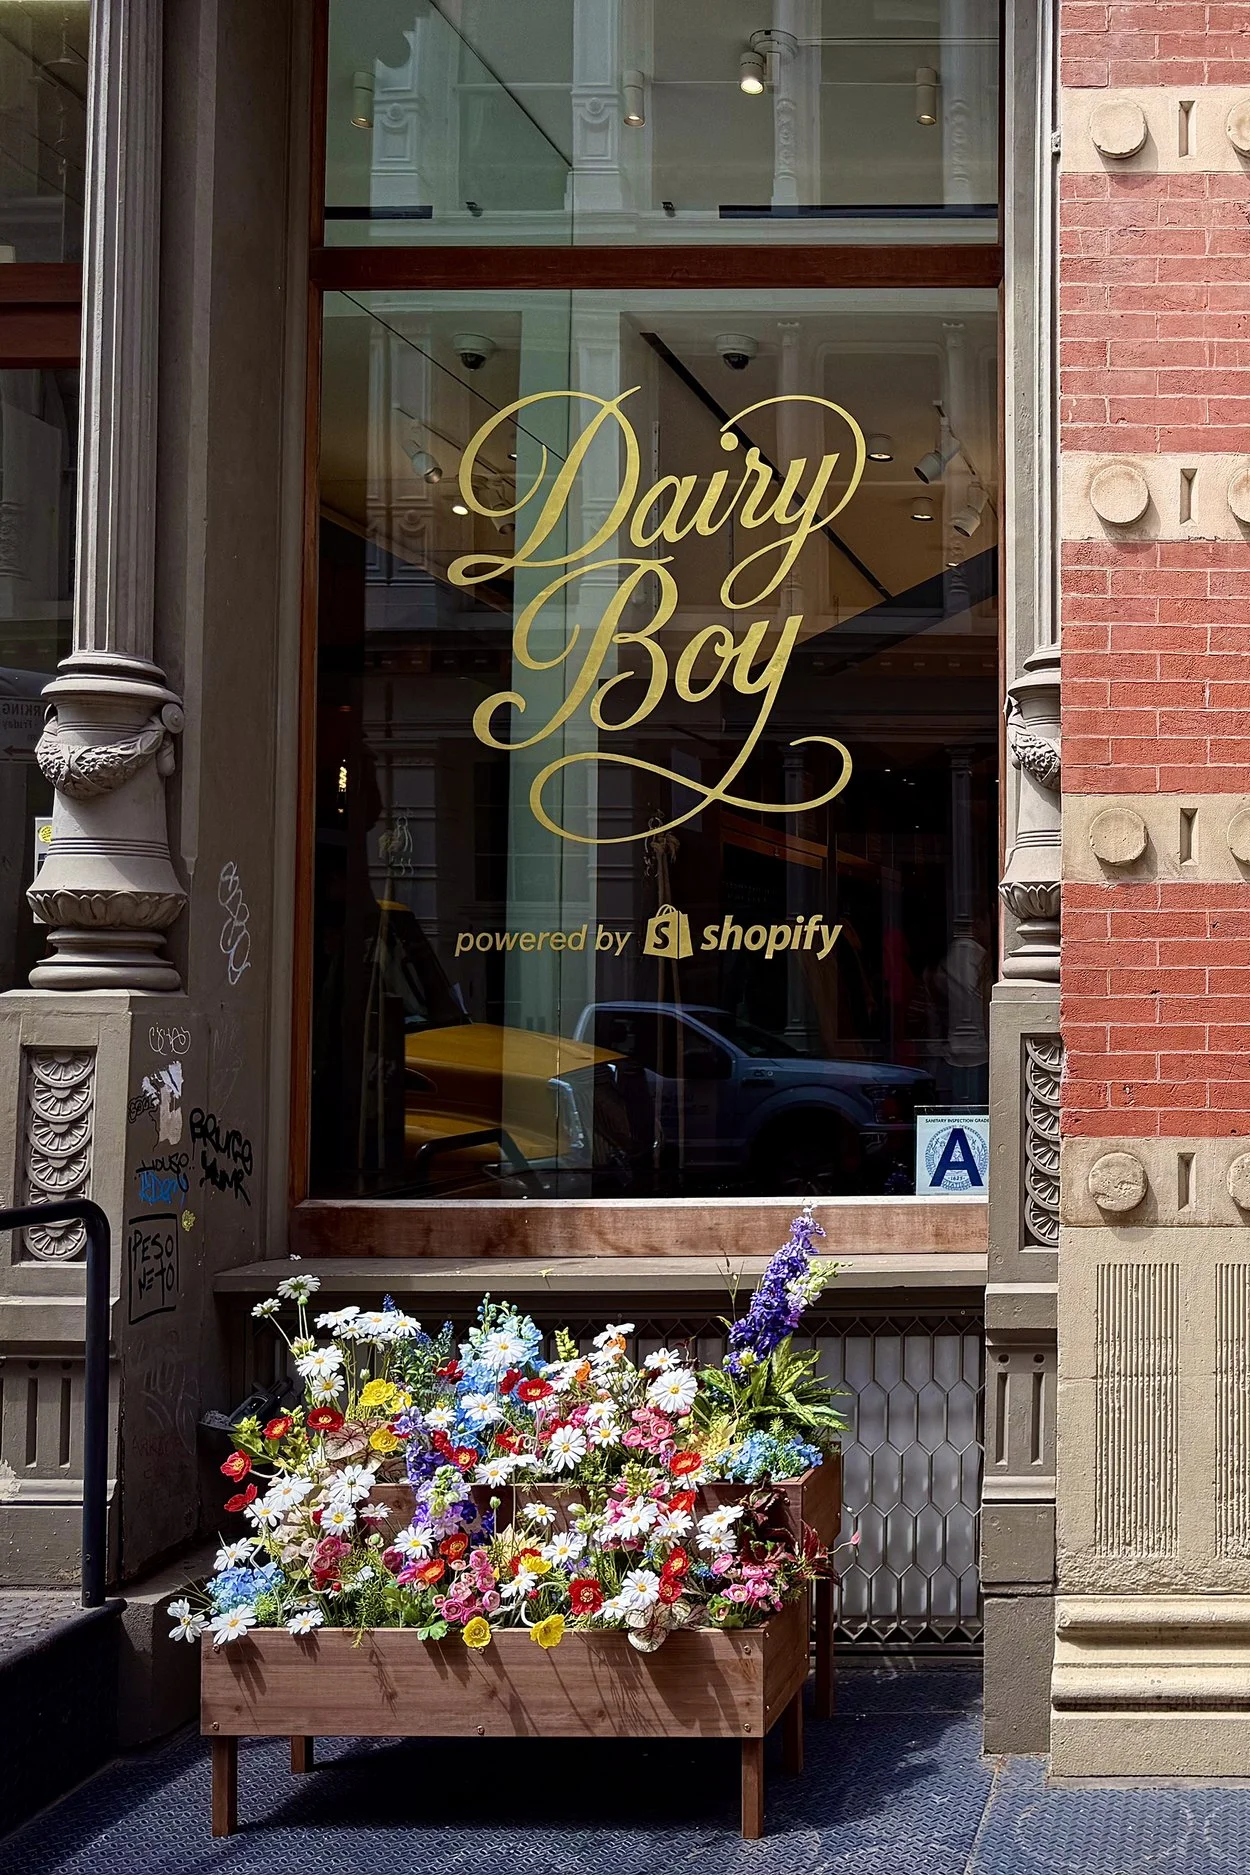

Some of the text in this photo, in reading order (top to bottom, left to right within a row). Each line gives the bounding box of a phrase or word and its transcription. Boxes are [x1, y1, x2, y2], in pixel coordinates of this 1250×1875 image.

[448, 386, 867, 610] Dairy
[473, 557, 853, 844] Boy
[455, 924, 588, 957] powered
[594, 924, 632, 956] by
[701, 914, 844, 960] shopify
[929, 1127, 984, 1187] A
[132, 1229, 174, 1271] PESO
[138, 1257, 174, 1306] NETO
